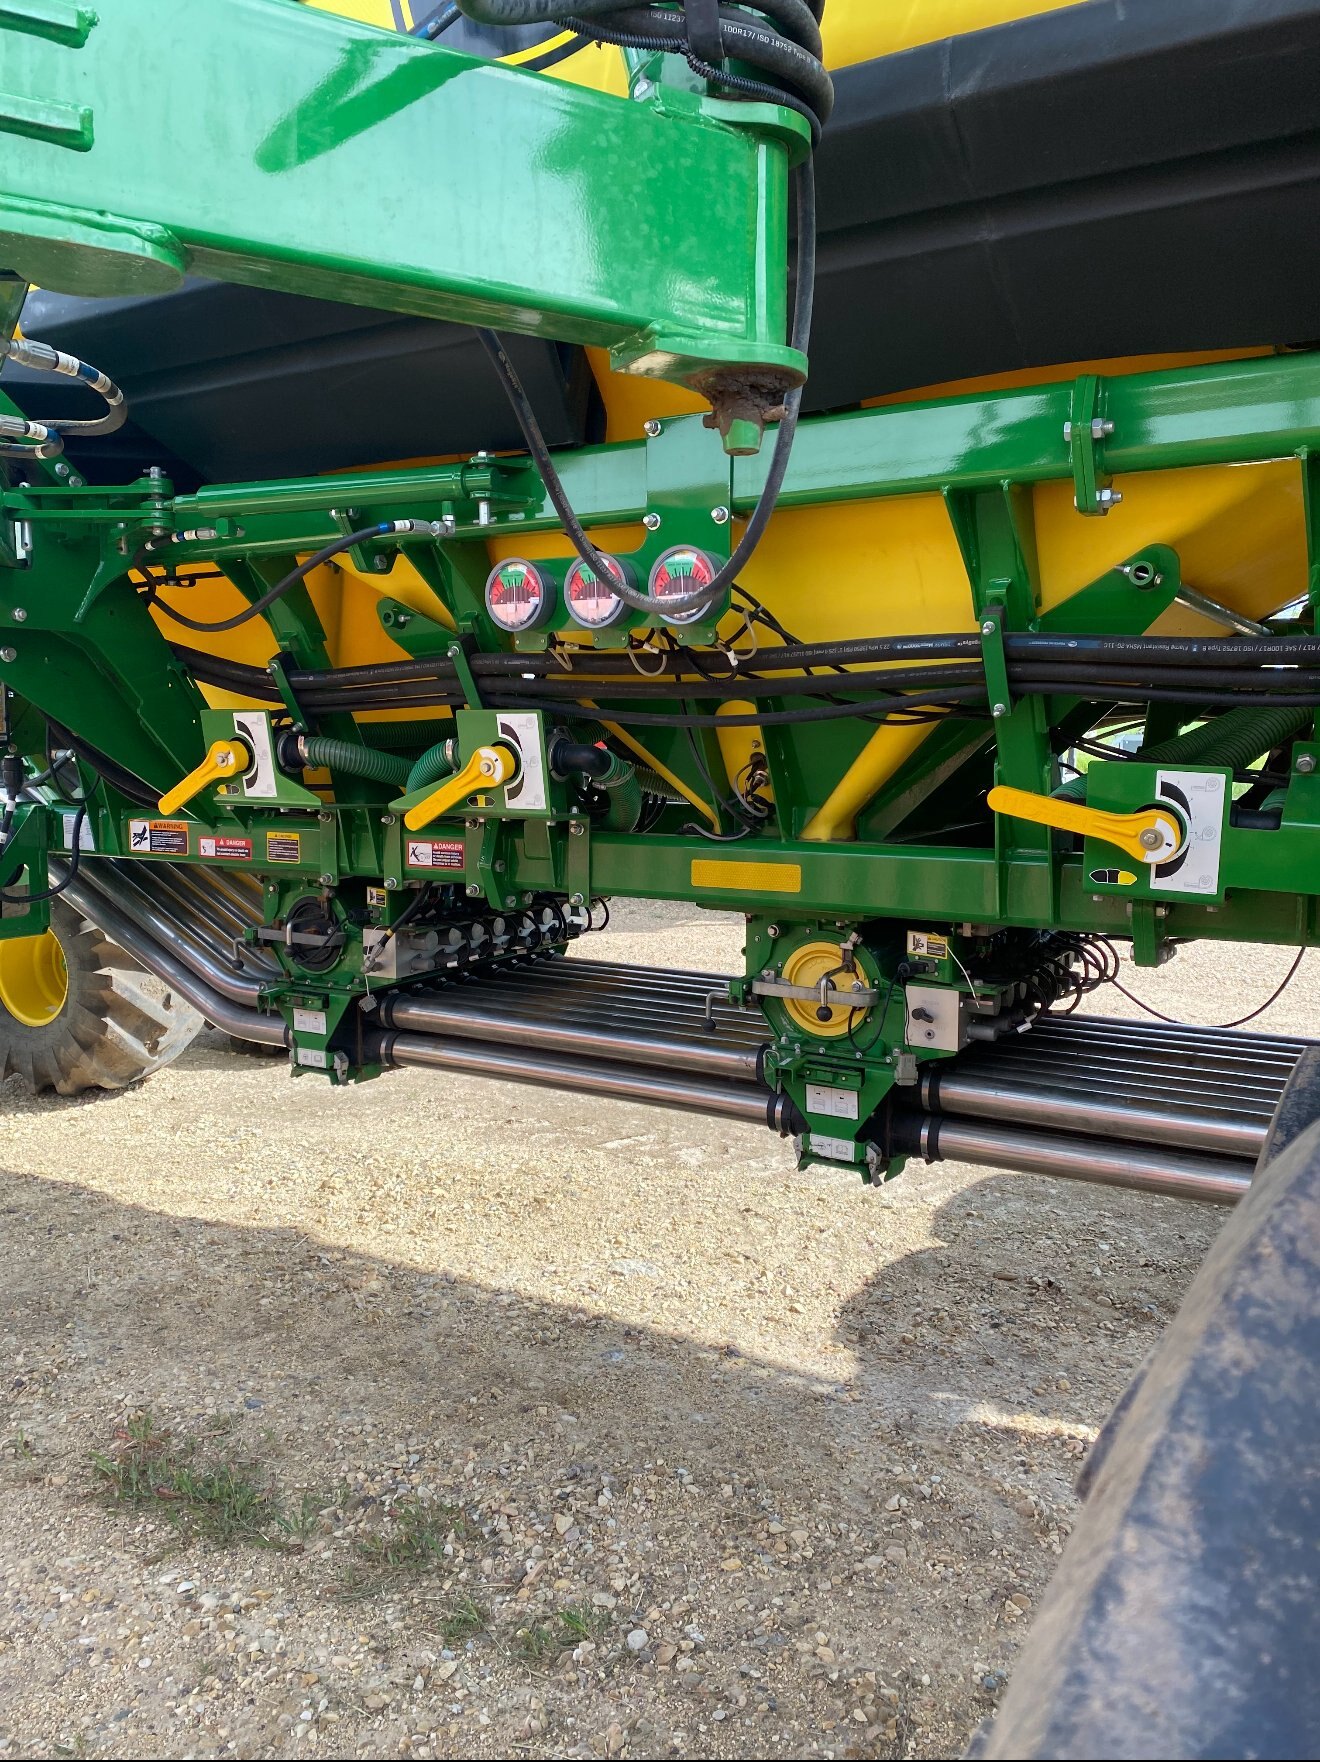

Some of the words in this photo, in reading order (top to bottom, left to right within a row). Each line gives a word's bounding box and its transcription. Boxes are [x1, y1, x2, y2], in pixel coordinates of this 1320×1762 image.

[664, 13, 686, 23] 11237
[757, 34, 770, 43] ISO
[771, 38, 792, 53] 18752
